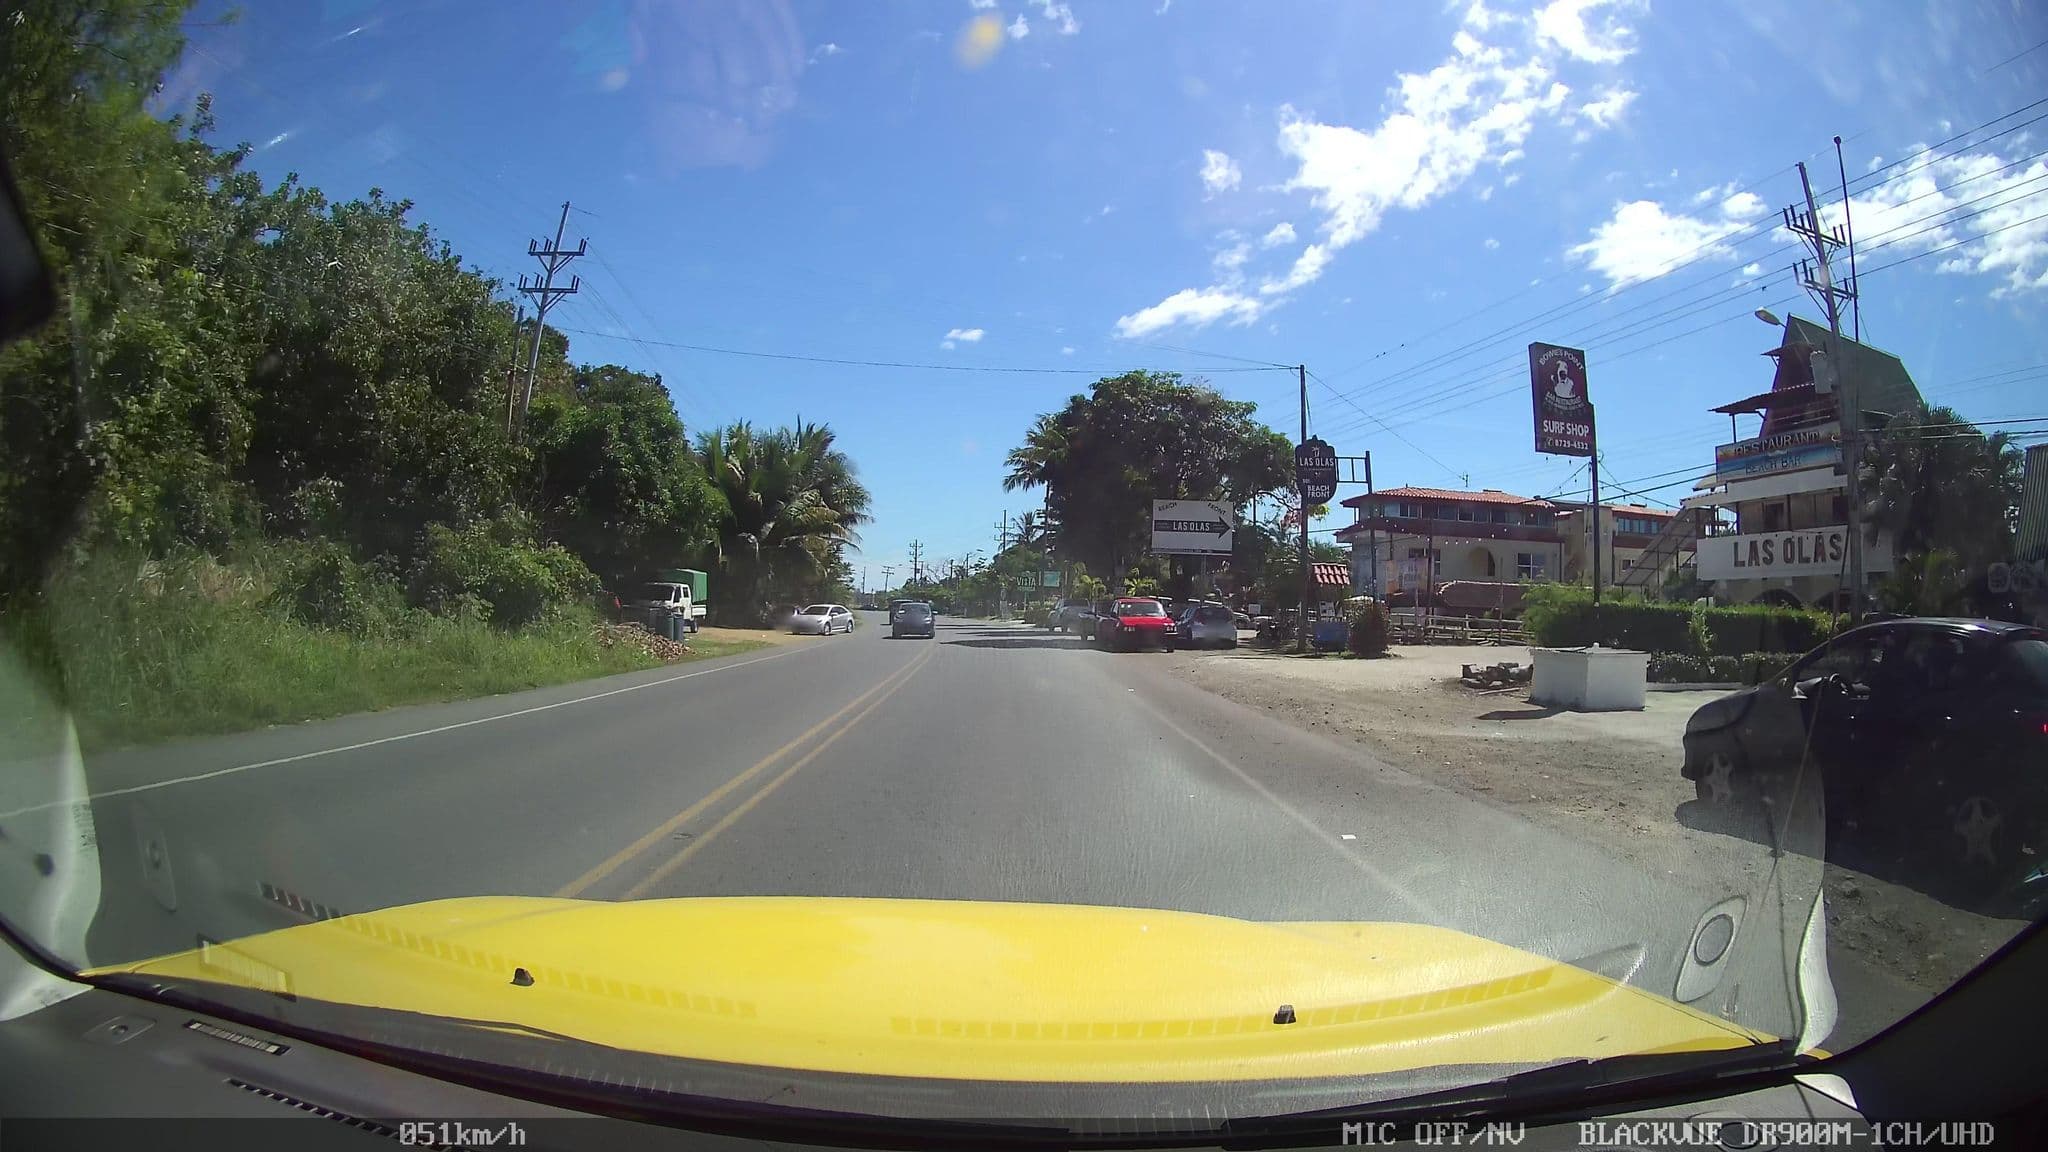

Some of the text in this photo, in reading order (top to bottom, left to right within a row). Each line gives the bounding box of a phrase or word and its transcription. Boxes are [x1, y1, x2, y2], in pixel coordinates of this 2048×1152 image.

[1543, 420, 1590, 437] SURF SHOP
[1300, 457, 1335, 467] LAS OLAS
[1745, 455, 1801, 474] BEACH BAR
[1207, 502, 1227, 515] FRONT
[1172, 521, 1188, 532] LAS
[1189, 522, 1210, 532] OLAS
[1733, 533, 1843, 568] LAS OLAS
